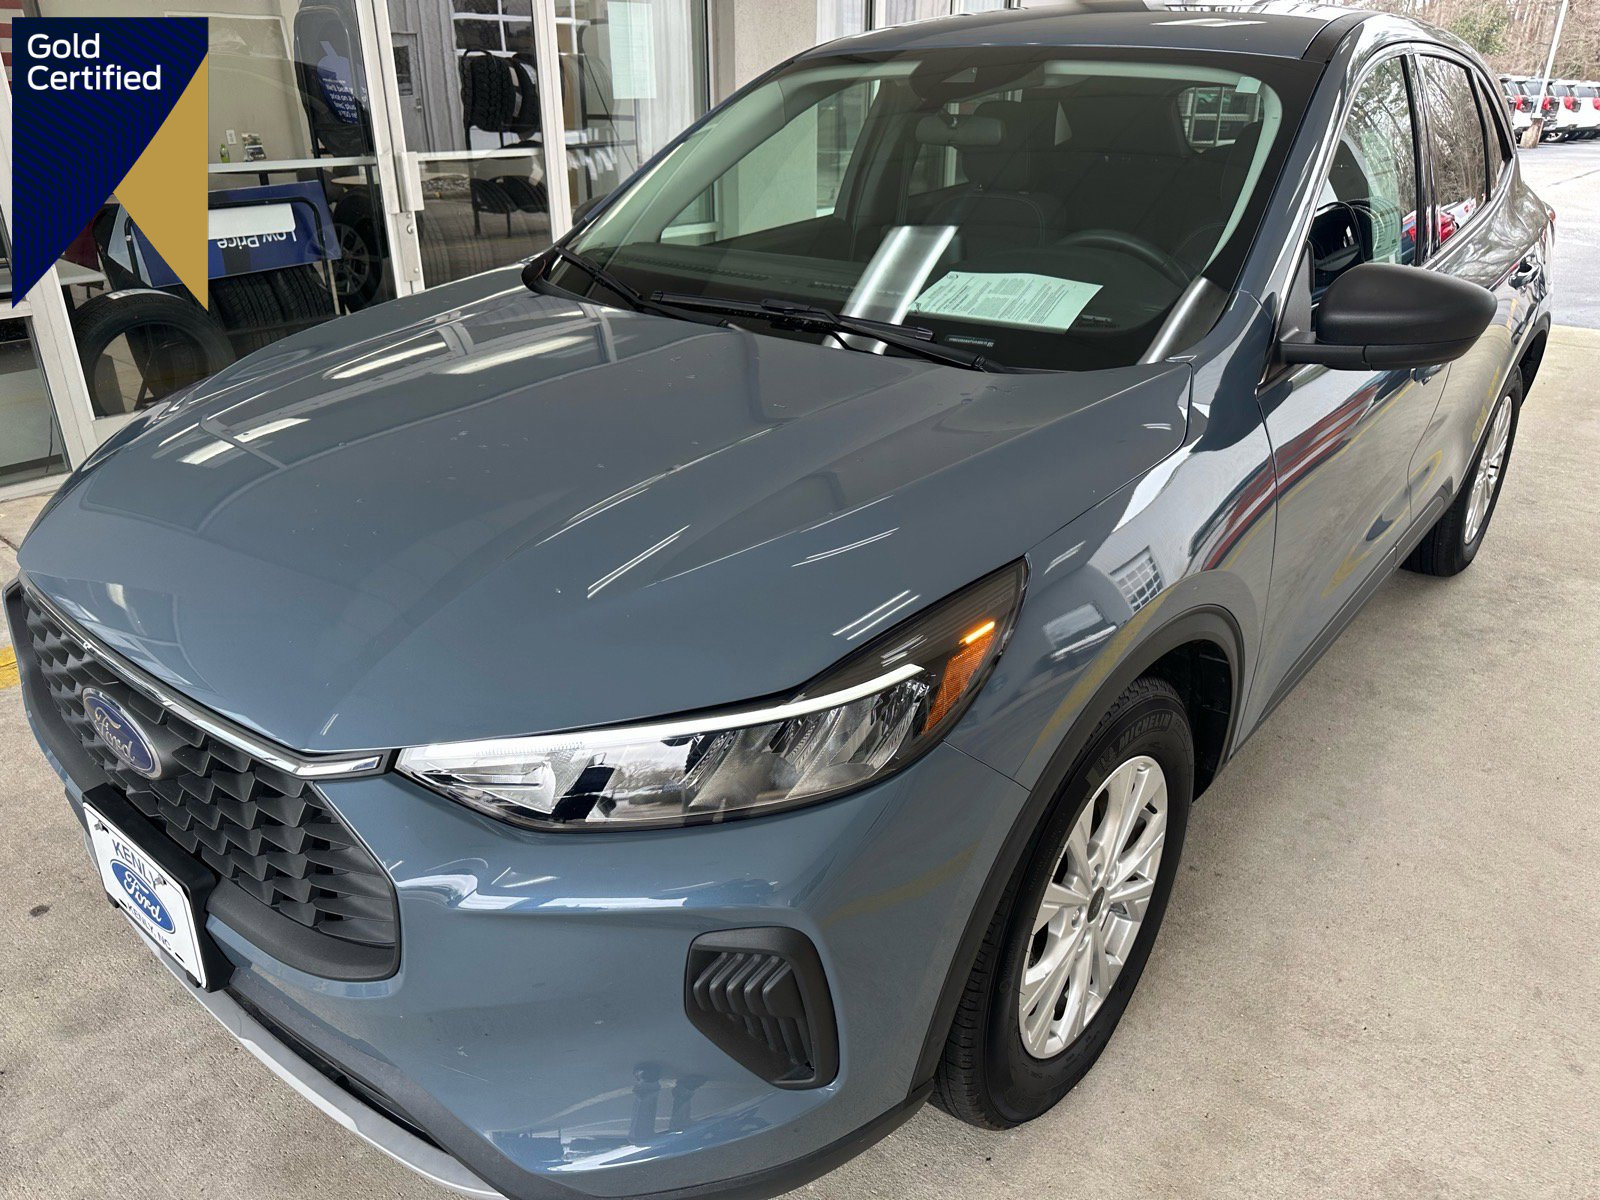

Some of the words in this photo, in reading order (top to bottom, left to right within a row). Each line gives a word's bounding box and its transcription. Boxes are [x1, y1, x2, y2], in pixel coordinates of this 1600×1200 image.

[216, 234, 260, 250] Price
[95, 706, 137, 763] Ford
[1119, 712, 1172, 750] MICHELIN
[111, 838, 157, 891] KENLY
[123, 870, 163, 922] Ford
